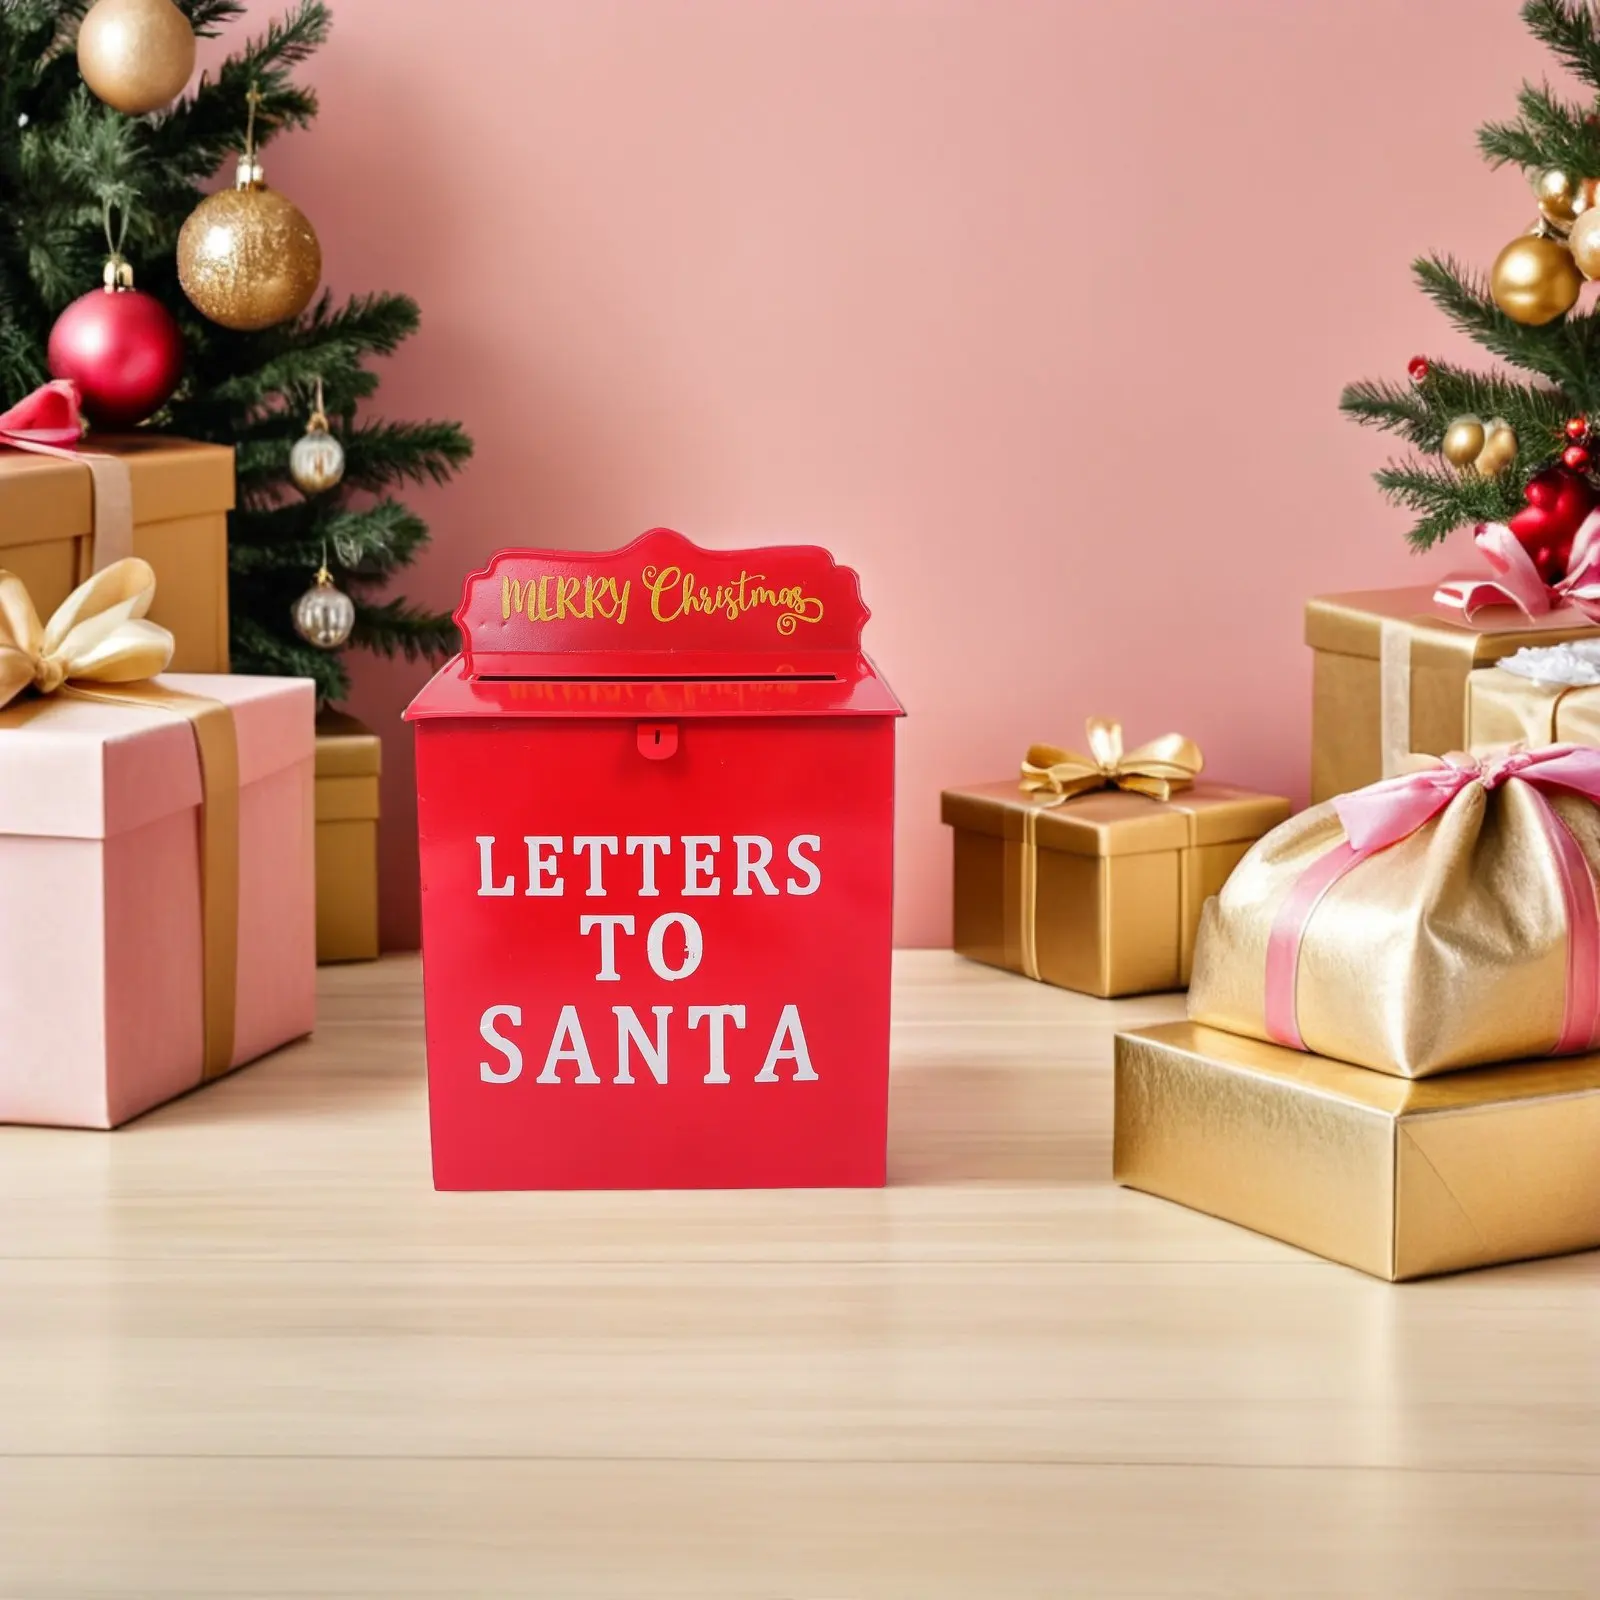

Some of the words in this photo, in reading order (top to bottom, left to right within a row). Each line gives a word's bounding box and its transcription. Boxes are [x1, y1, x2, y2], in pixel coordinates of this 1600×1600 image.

[502, 575, 630, 624] MERRY
[642, 565, 824, 635] Christmas
[475, 834, 822, 897] LETTERS
[580, 912, 703, 982] TO
[479, 1004, 819, 1085] SANTA
